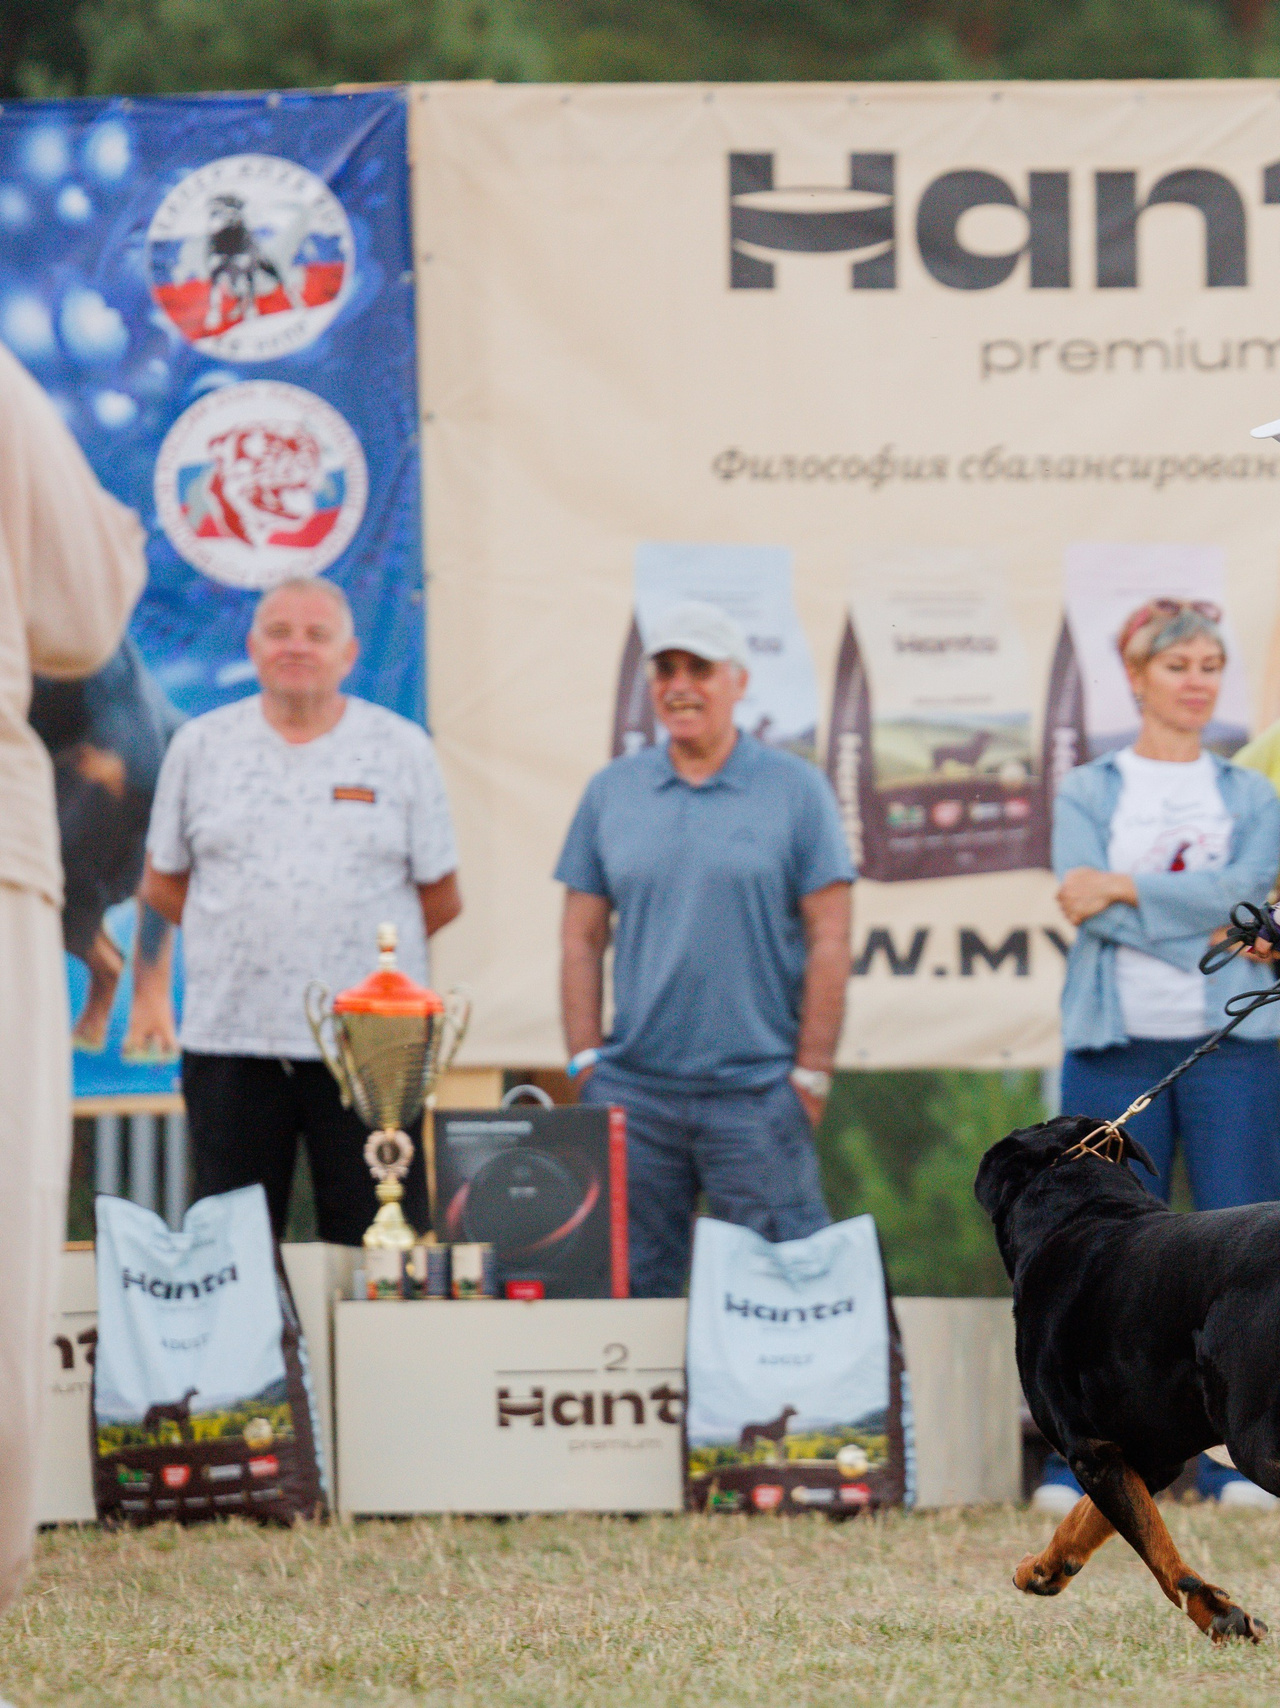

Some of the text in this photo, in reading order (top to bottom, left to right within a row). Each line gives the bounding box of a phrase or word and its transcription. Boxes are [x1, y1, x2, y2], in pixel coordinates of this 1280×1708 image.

[711, 443, 949, 491] Философия
[122, 1262, 240, 1300] Hanta
[725, 1291, 855, 1322] Hanta
[603, 1342, 629, 1371] 2
[497, 1384, 683, 1427] Hant
